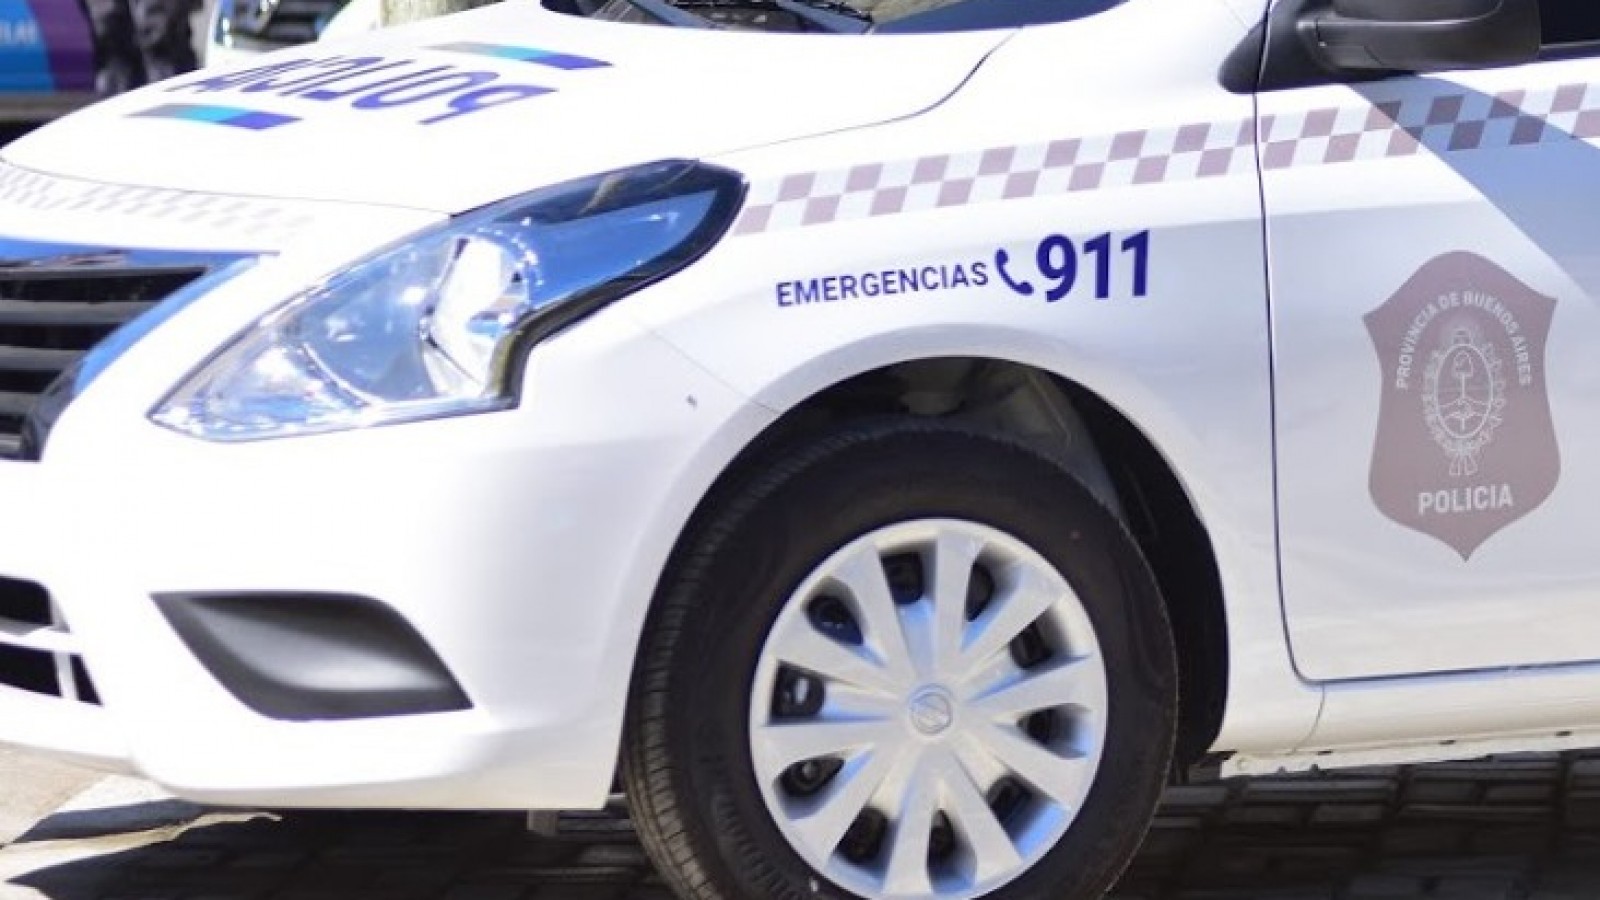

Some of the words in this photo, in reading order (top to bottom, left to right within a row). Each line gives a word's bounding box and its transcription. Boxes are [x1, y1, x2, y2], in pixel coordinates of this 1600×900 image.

[776, 262, 989, 307] EMERGENCIAS
[1036, 229, 1151, 303] 911
[1396, 304, 1439, 390] PROVINCIA
[1438, 292, 1461, 308] DE
[1463, 290, 1521, 335] BUENOS
[1512, 335, 1532, 387] AIRES
[1418, 484, 1514, 515] POLICIA
